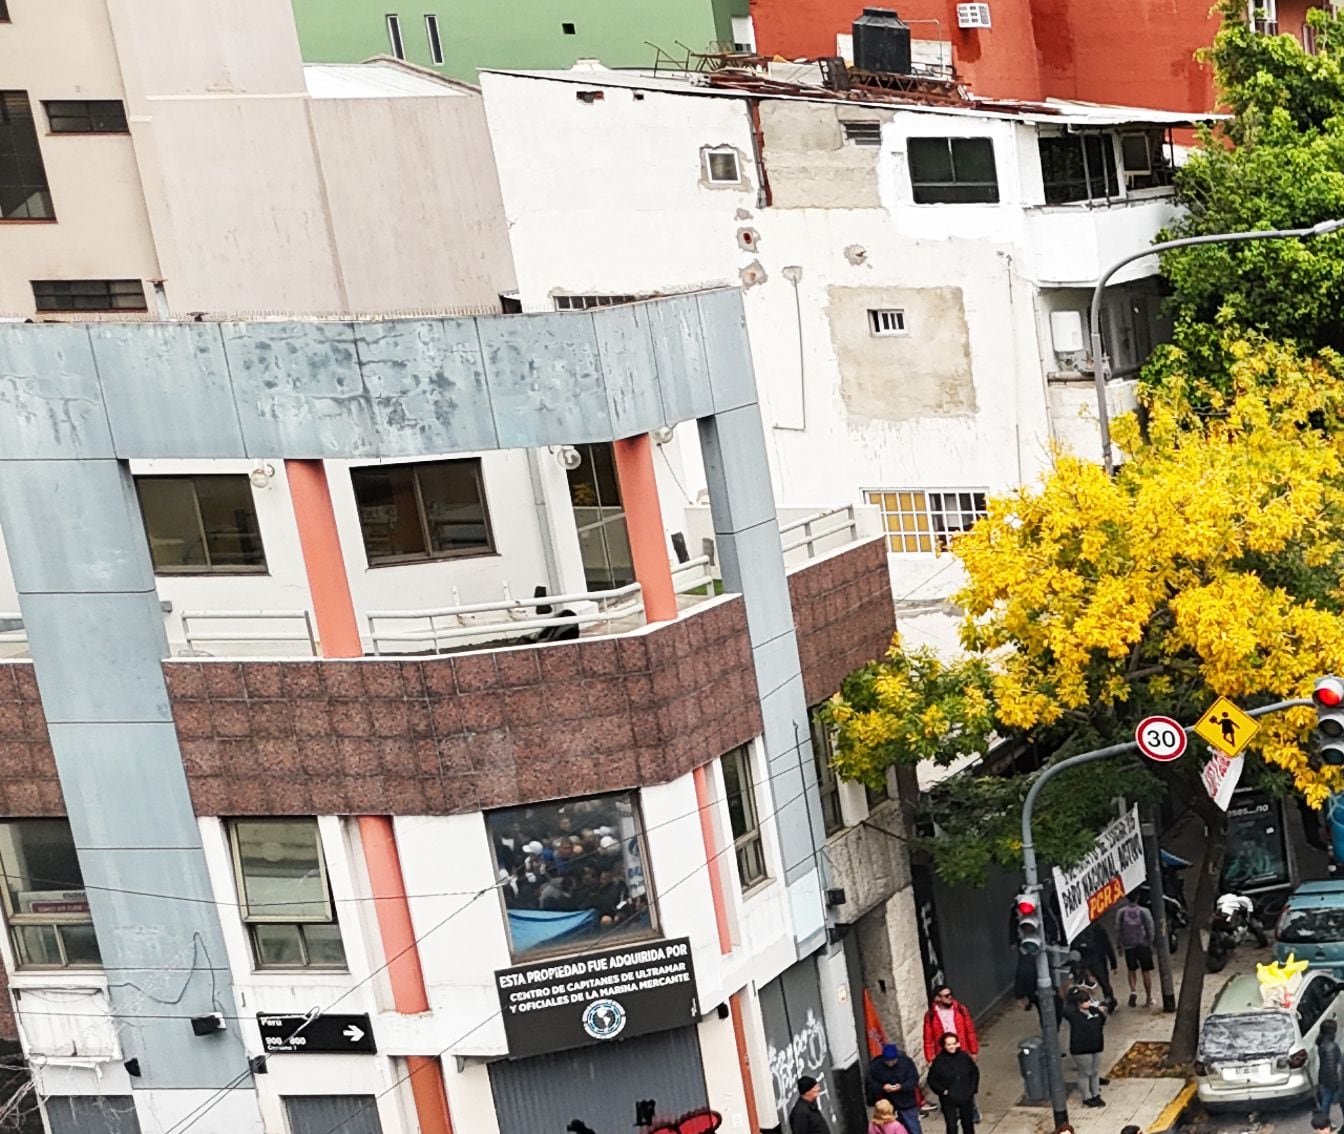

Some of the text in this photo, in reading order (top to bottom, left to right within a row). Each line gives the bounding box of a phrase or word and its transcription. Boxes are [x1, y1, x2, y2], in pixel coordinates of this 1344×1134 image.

[1146, 729, 1176, 748] 30
[499, 943, 688, 988] ESTA PROPIEDAD FUE ADQUIRIDA POR
[509, 962, 687, 1002] CENTRO DE CAPITANES DE ULTRAMAR
[509, 972, 690, 1014] Y OFICIALES DE LA MARINA MERCANTE
